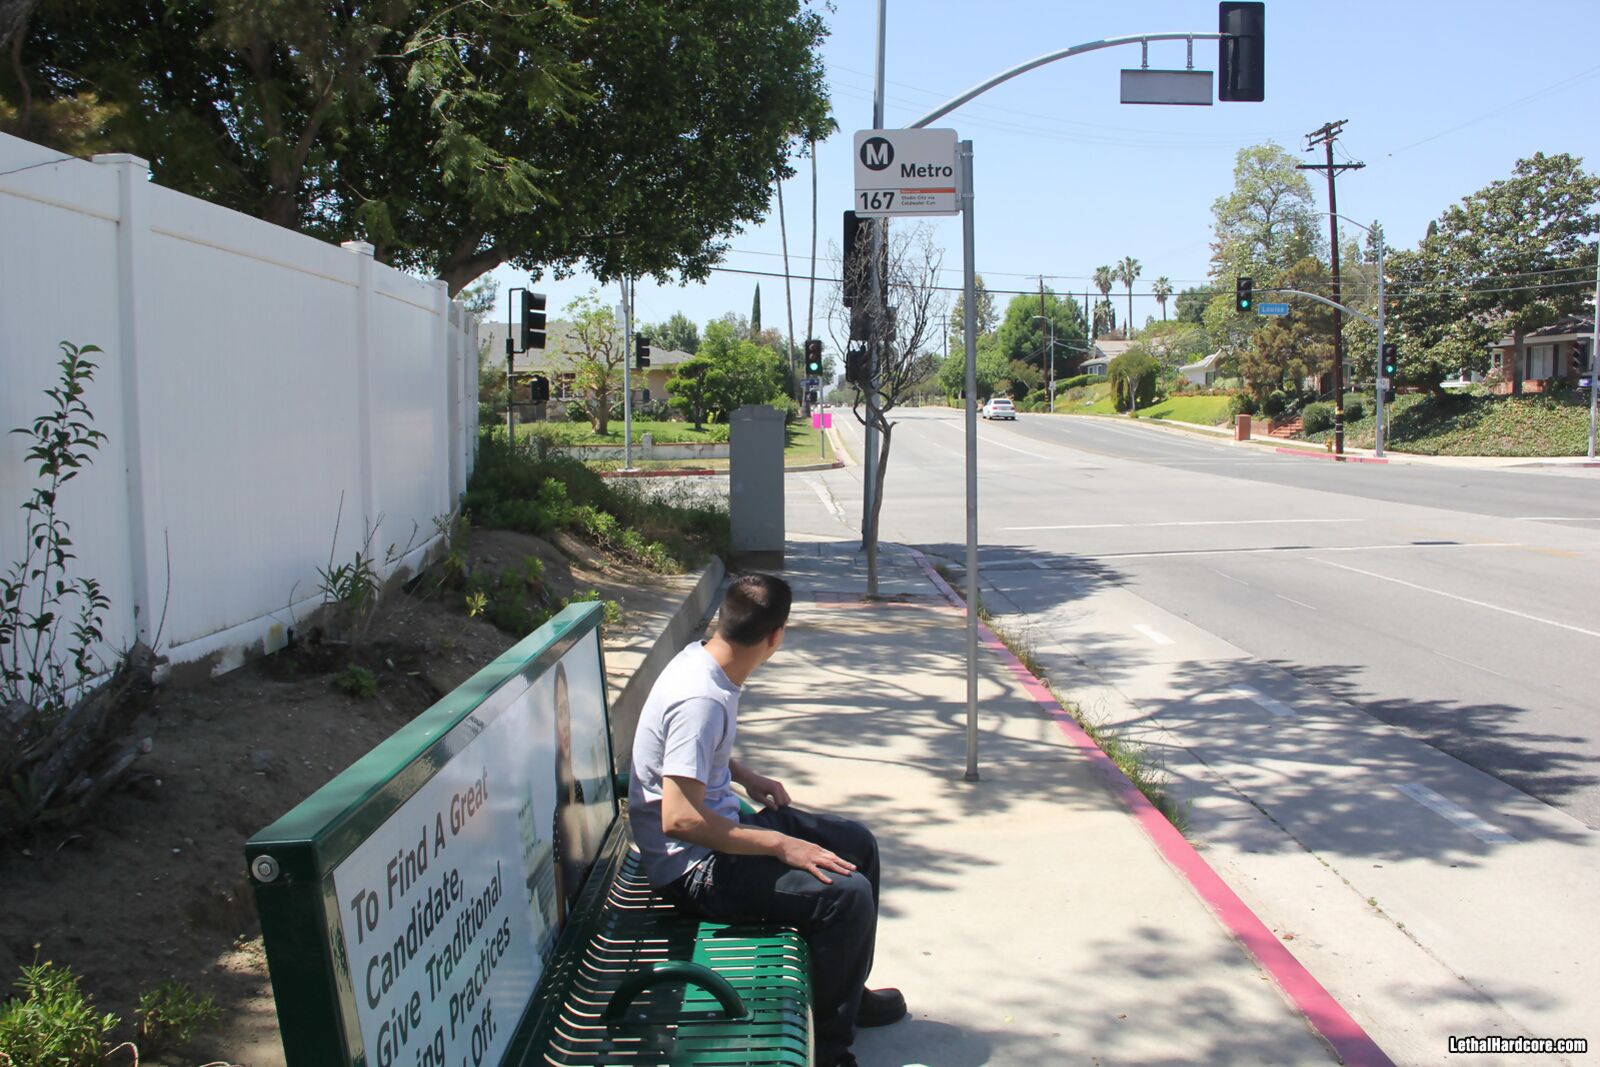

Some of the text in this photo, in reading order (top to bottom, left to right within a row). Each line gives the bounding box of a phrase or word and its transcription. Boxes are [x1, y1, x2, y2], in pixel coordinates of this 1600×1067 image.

[860, 191, 895, 210] 167
[865, 142, 889, 166] M
[900, 163, 954, 179] Metro
[351, 766, 489, 944] To Find A Great
[366, 867, 465, 1010] Candidate,
[376, 860, 502, 1067] Give Traditional
[449, 916, 511, 1041] Practices
[471, 997, 497, 1067] Off.
